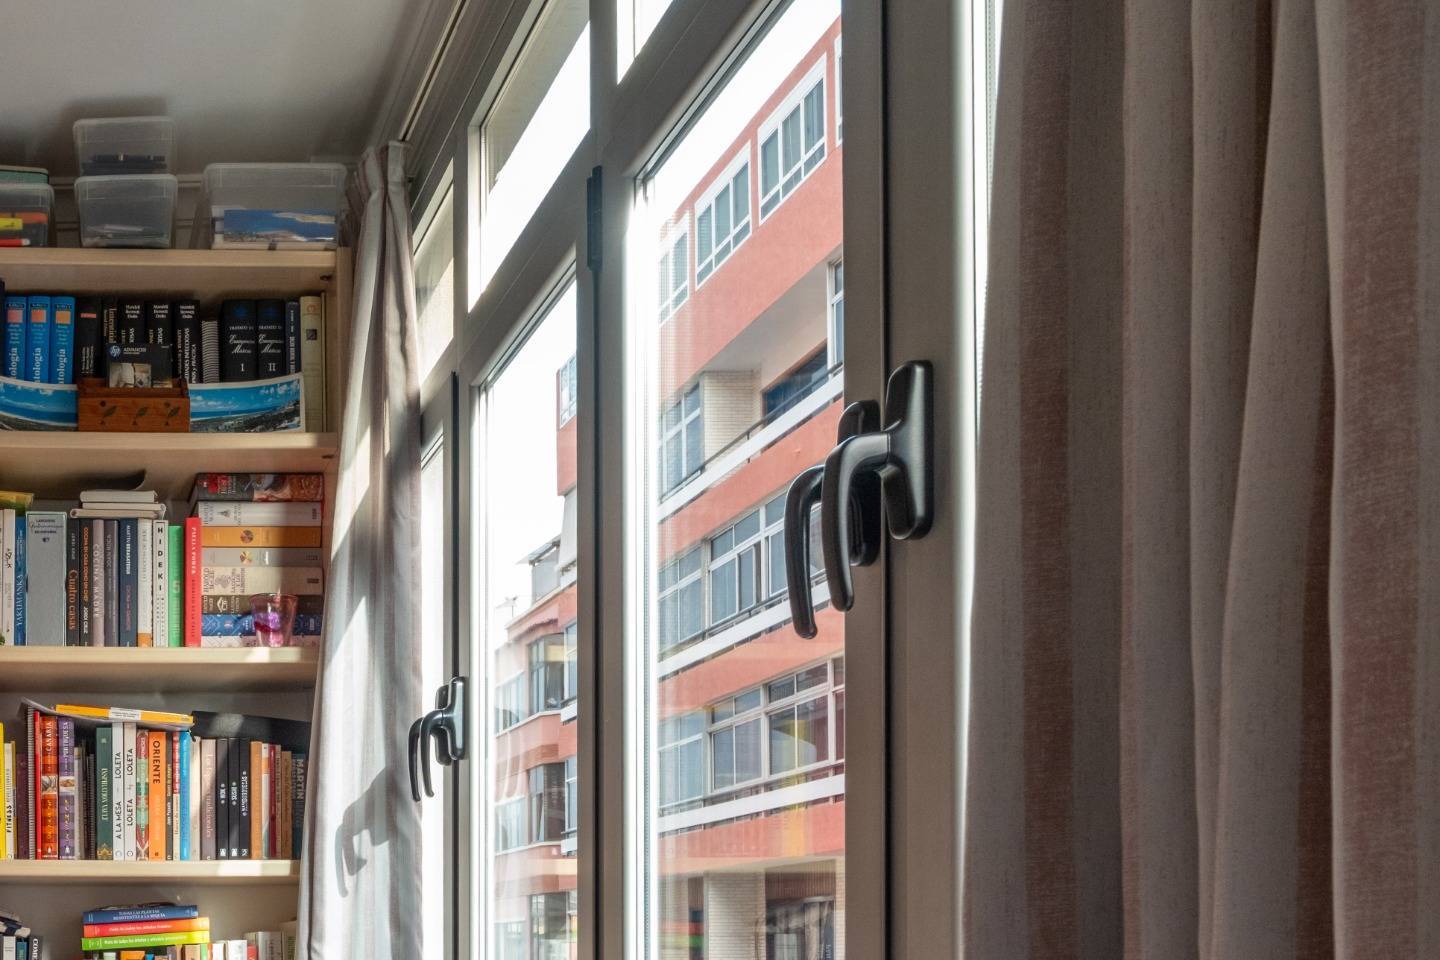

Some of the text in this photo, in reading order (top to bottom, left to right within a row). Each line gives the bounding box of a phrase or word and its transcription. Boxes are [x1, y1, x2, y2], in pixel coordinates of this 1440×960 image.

[69, 570, 79, 631] Cuatro casas
[45, 720, 53, 752] CANARIA
[153, 740, 161, 785] ORIENTE
[115, 822, 122, 833] LA
